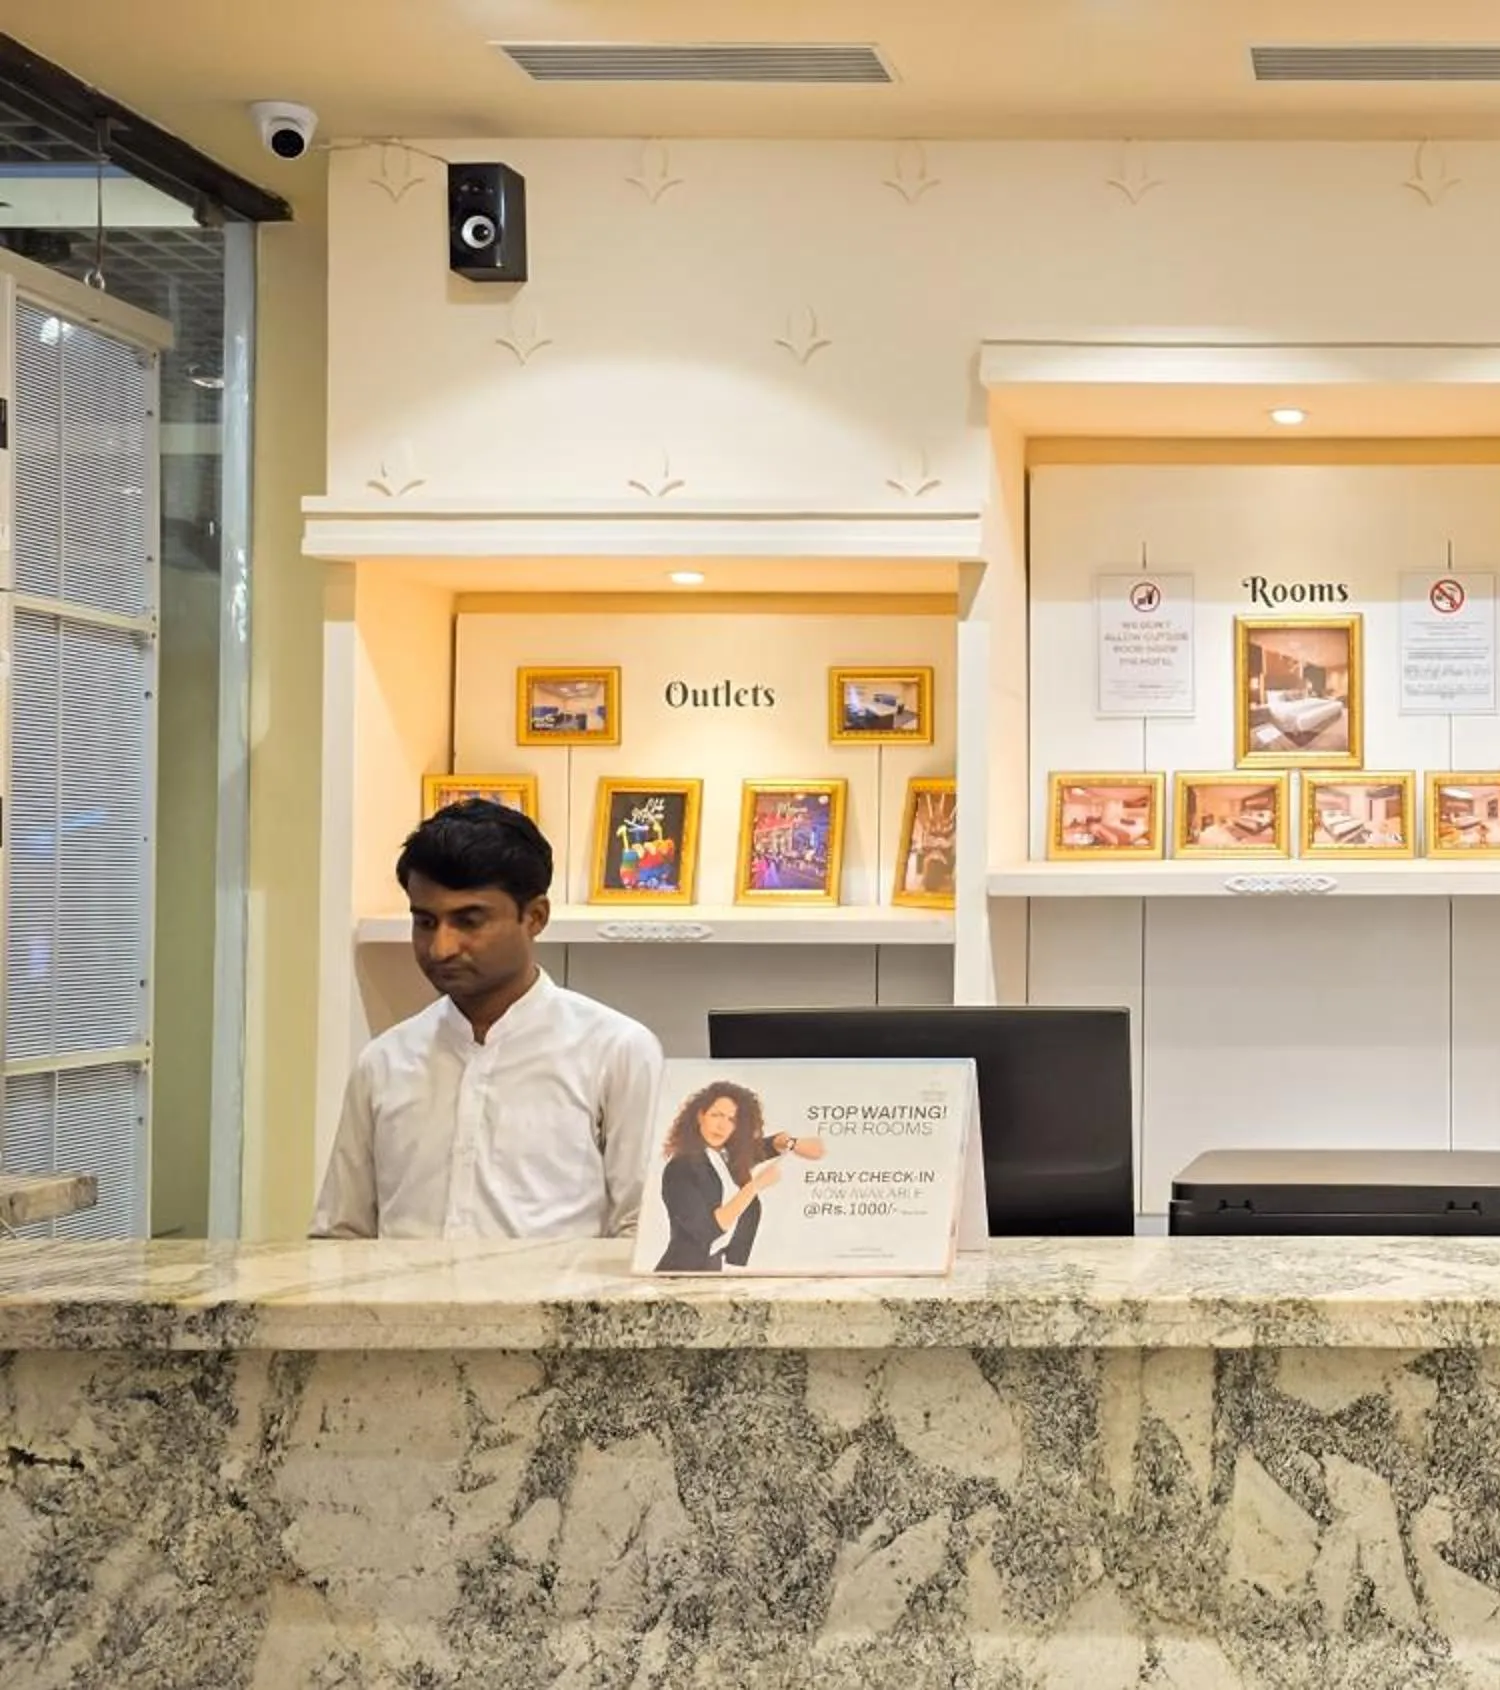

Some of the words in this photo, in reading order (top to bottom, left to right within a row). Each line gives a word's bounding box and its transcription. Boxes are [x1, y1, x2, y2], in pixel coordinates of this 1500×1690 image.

[1241, 575, 1349, 608] Rooms
[664, 679, 776, 708] Outlets
[807, 1105, 858, 1120] STOP
[861, 1105, 947, 1120] WAITING!
[817, 1121, 856, 1136] FOR
[862, 1121, 933, 1136] ROOMS
[804, 1171, 856, 1183] EARLY
[858, 1171, 935, 1183] CHECK-IN
[811, 1187, 846, 1199] NOW
[850, 1187, 924, 1199] AVAILABLE
